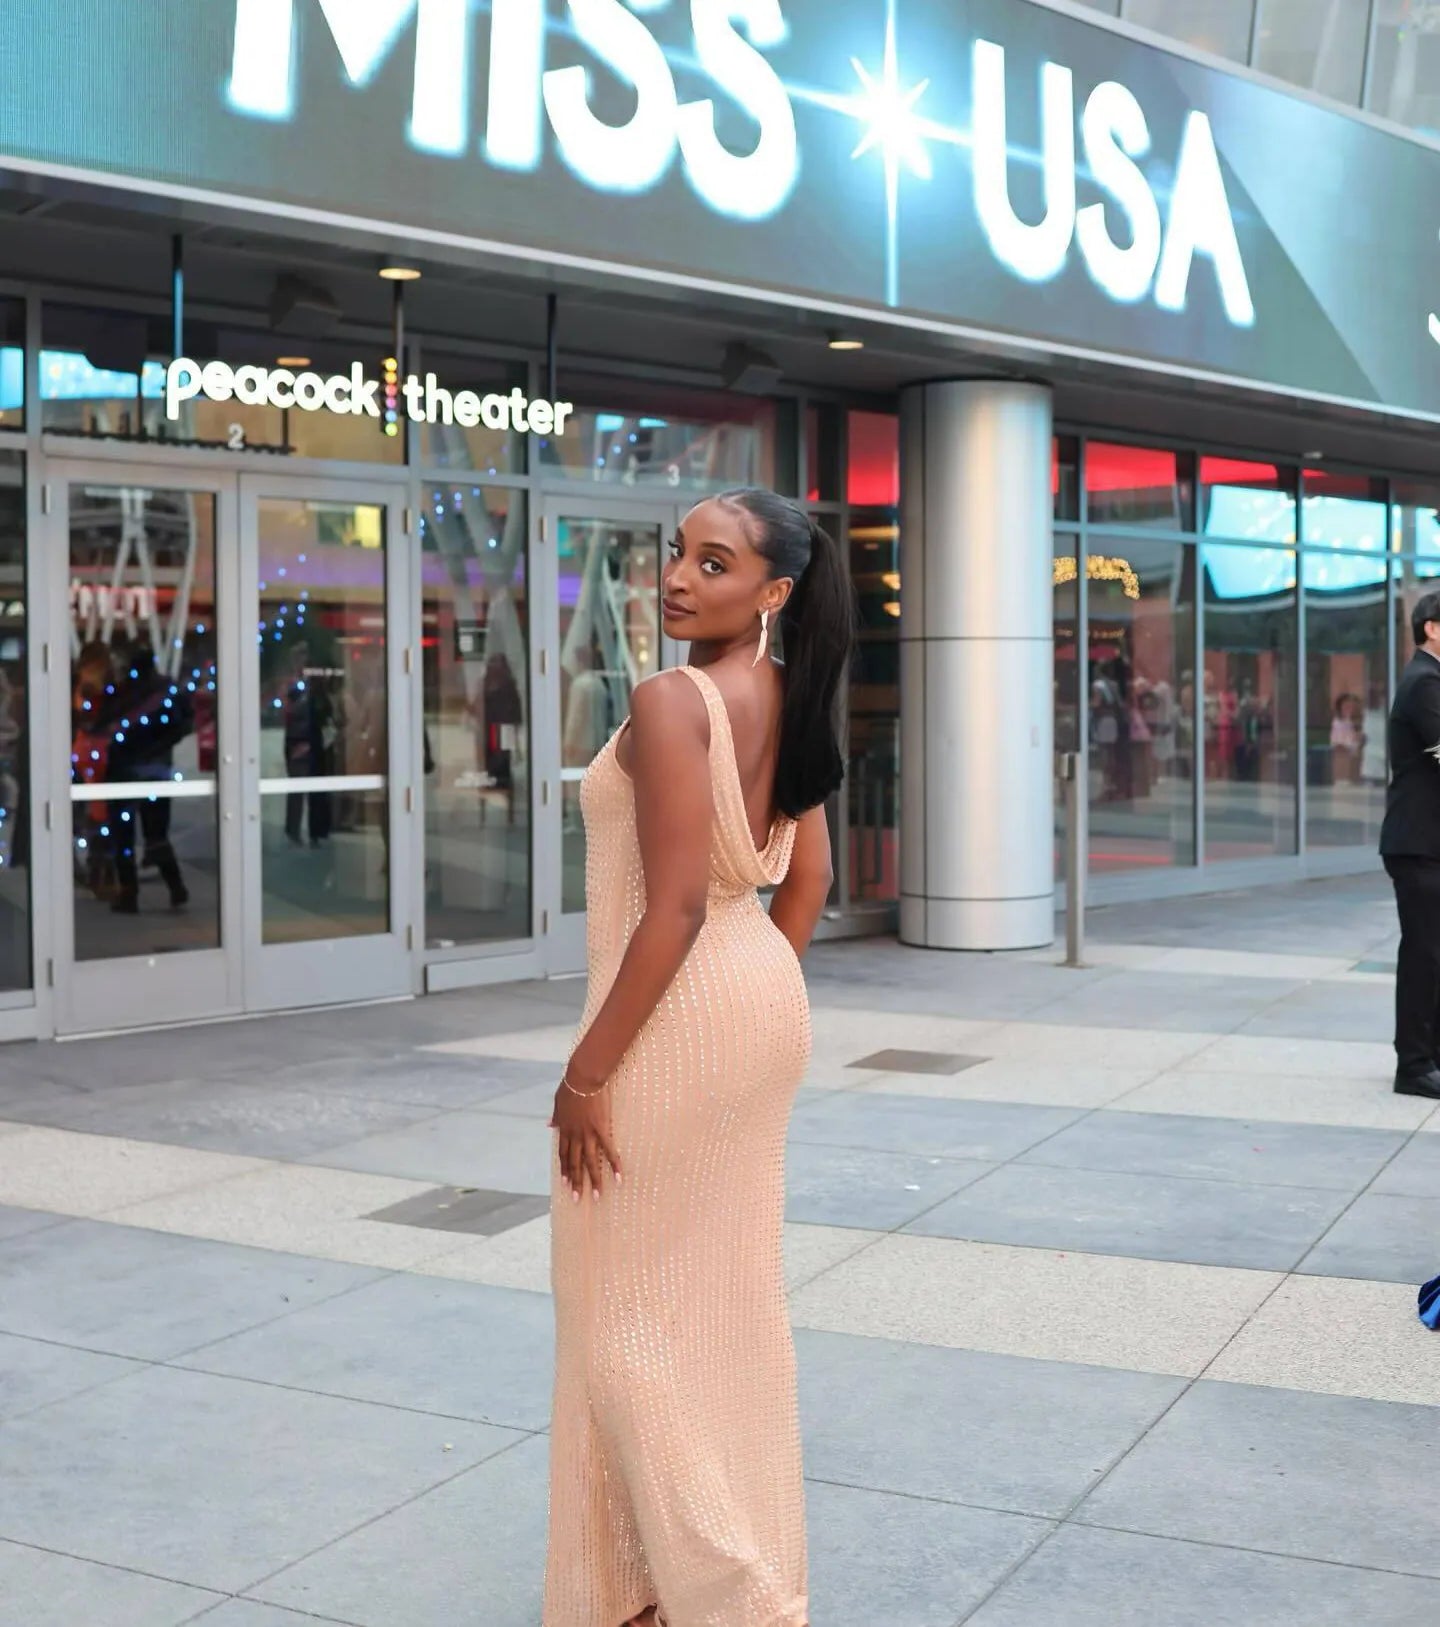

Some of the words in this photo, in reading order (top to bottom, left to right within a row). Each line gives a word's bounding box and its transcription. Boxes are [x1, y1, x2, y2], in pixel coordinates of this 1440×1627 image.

[971, 37, 1255, 327] USA
[166, 356, 381, 420] peacock
[403, 372, 574, 436] theater
[227, 422, 245, 449] 2
[667, 464, 680, 487] 3
